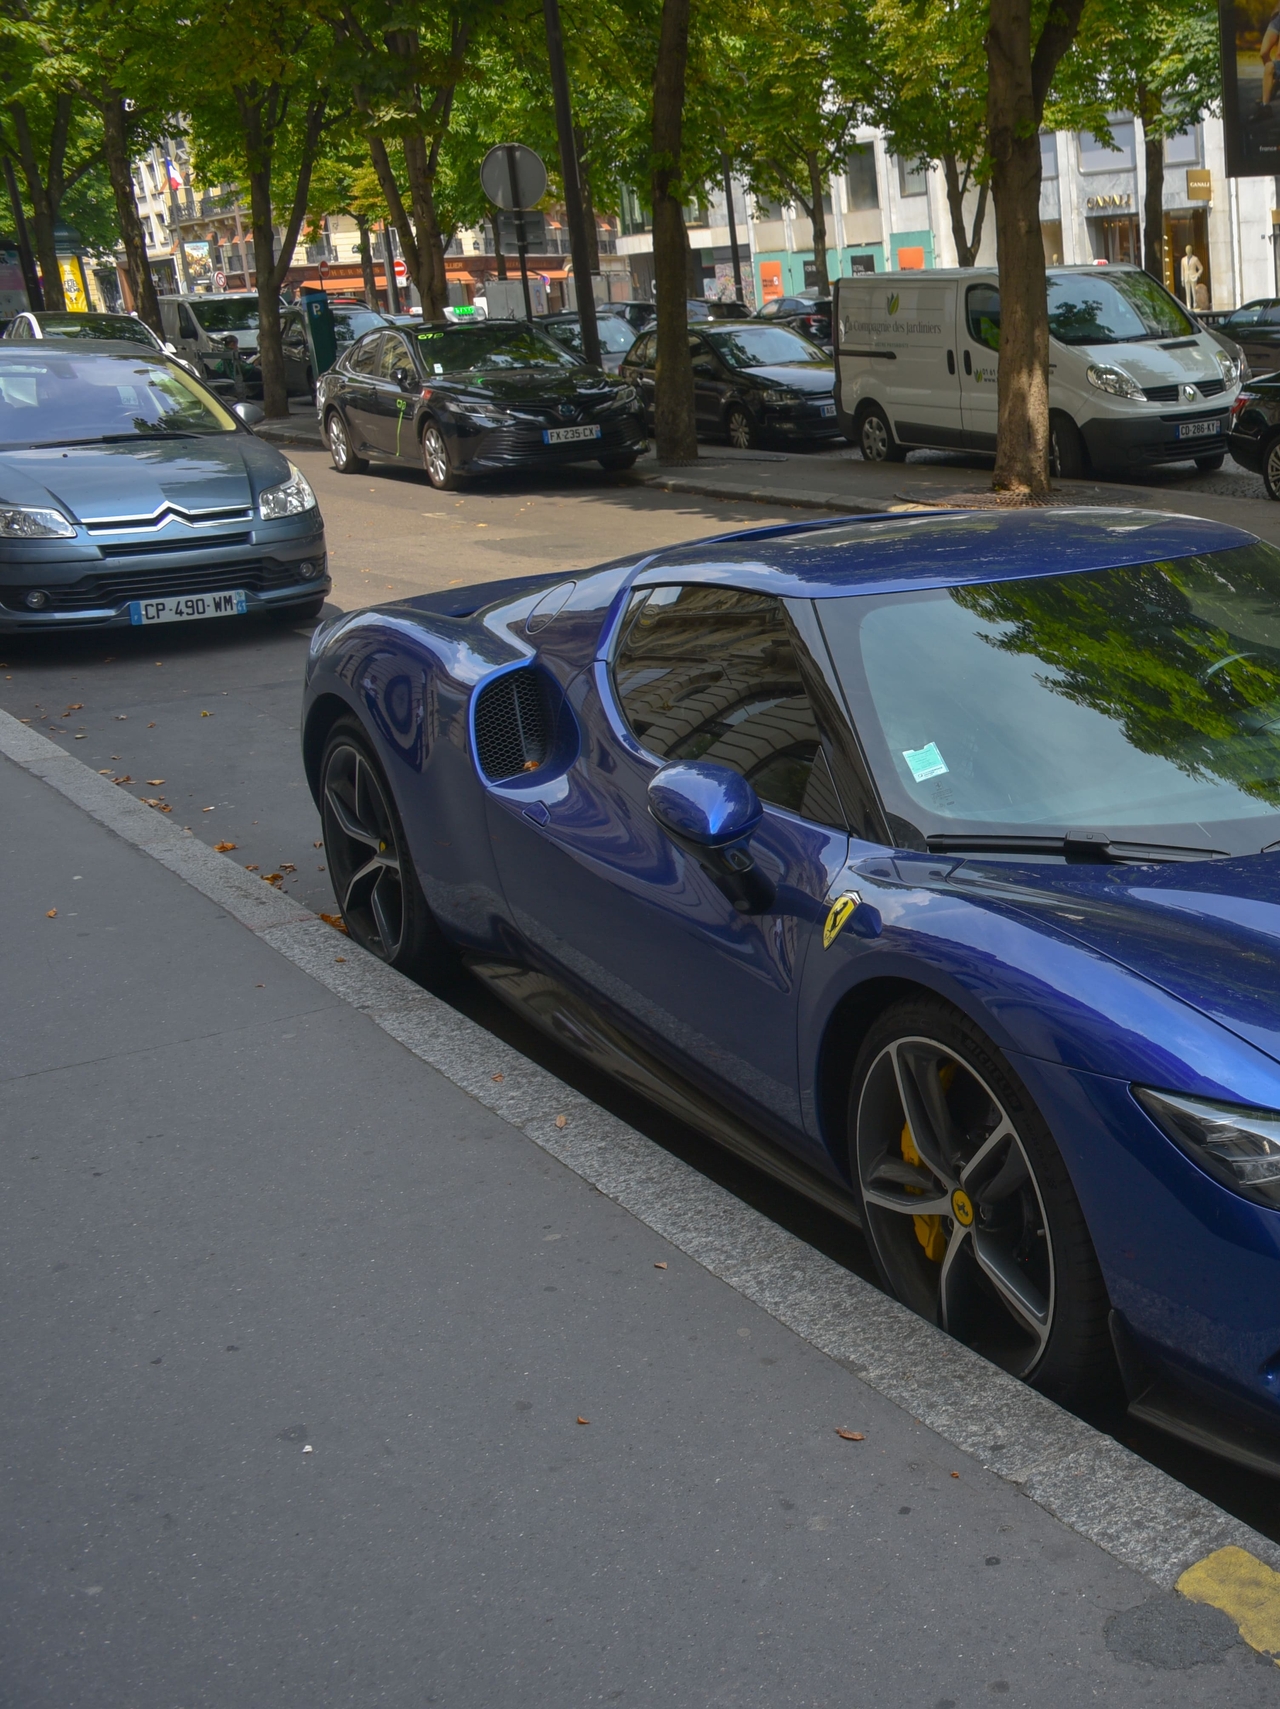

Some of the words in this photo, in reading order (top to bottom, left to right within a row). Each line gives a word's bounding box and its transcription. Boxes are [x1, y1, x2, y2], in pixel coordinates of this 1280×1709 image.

[1087, 193, 1133, 210] CANALI
[331, 265, 380, 277] HERMS
[853, 321, 892, 335] Compagnie
[892, 321, 905, 332] des
[906, 321, 942, 335] Jardiniers
[549, 426, 595, 442] FX-235-CX
[144, 595, 234, 620] CP-490-WM
[964, 1038, 1021, 1108] MICHELIN
